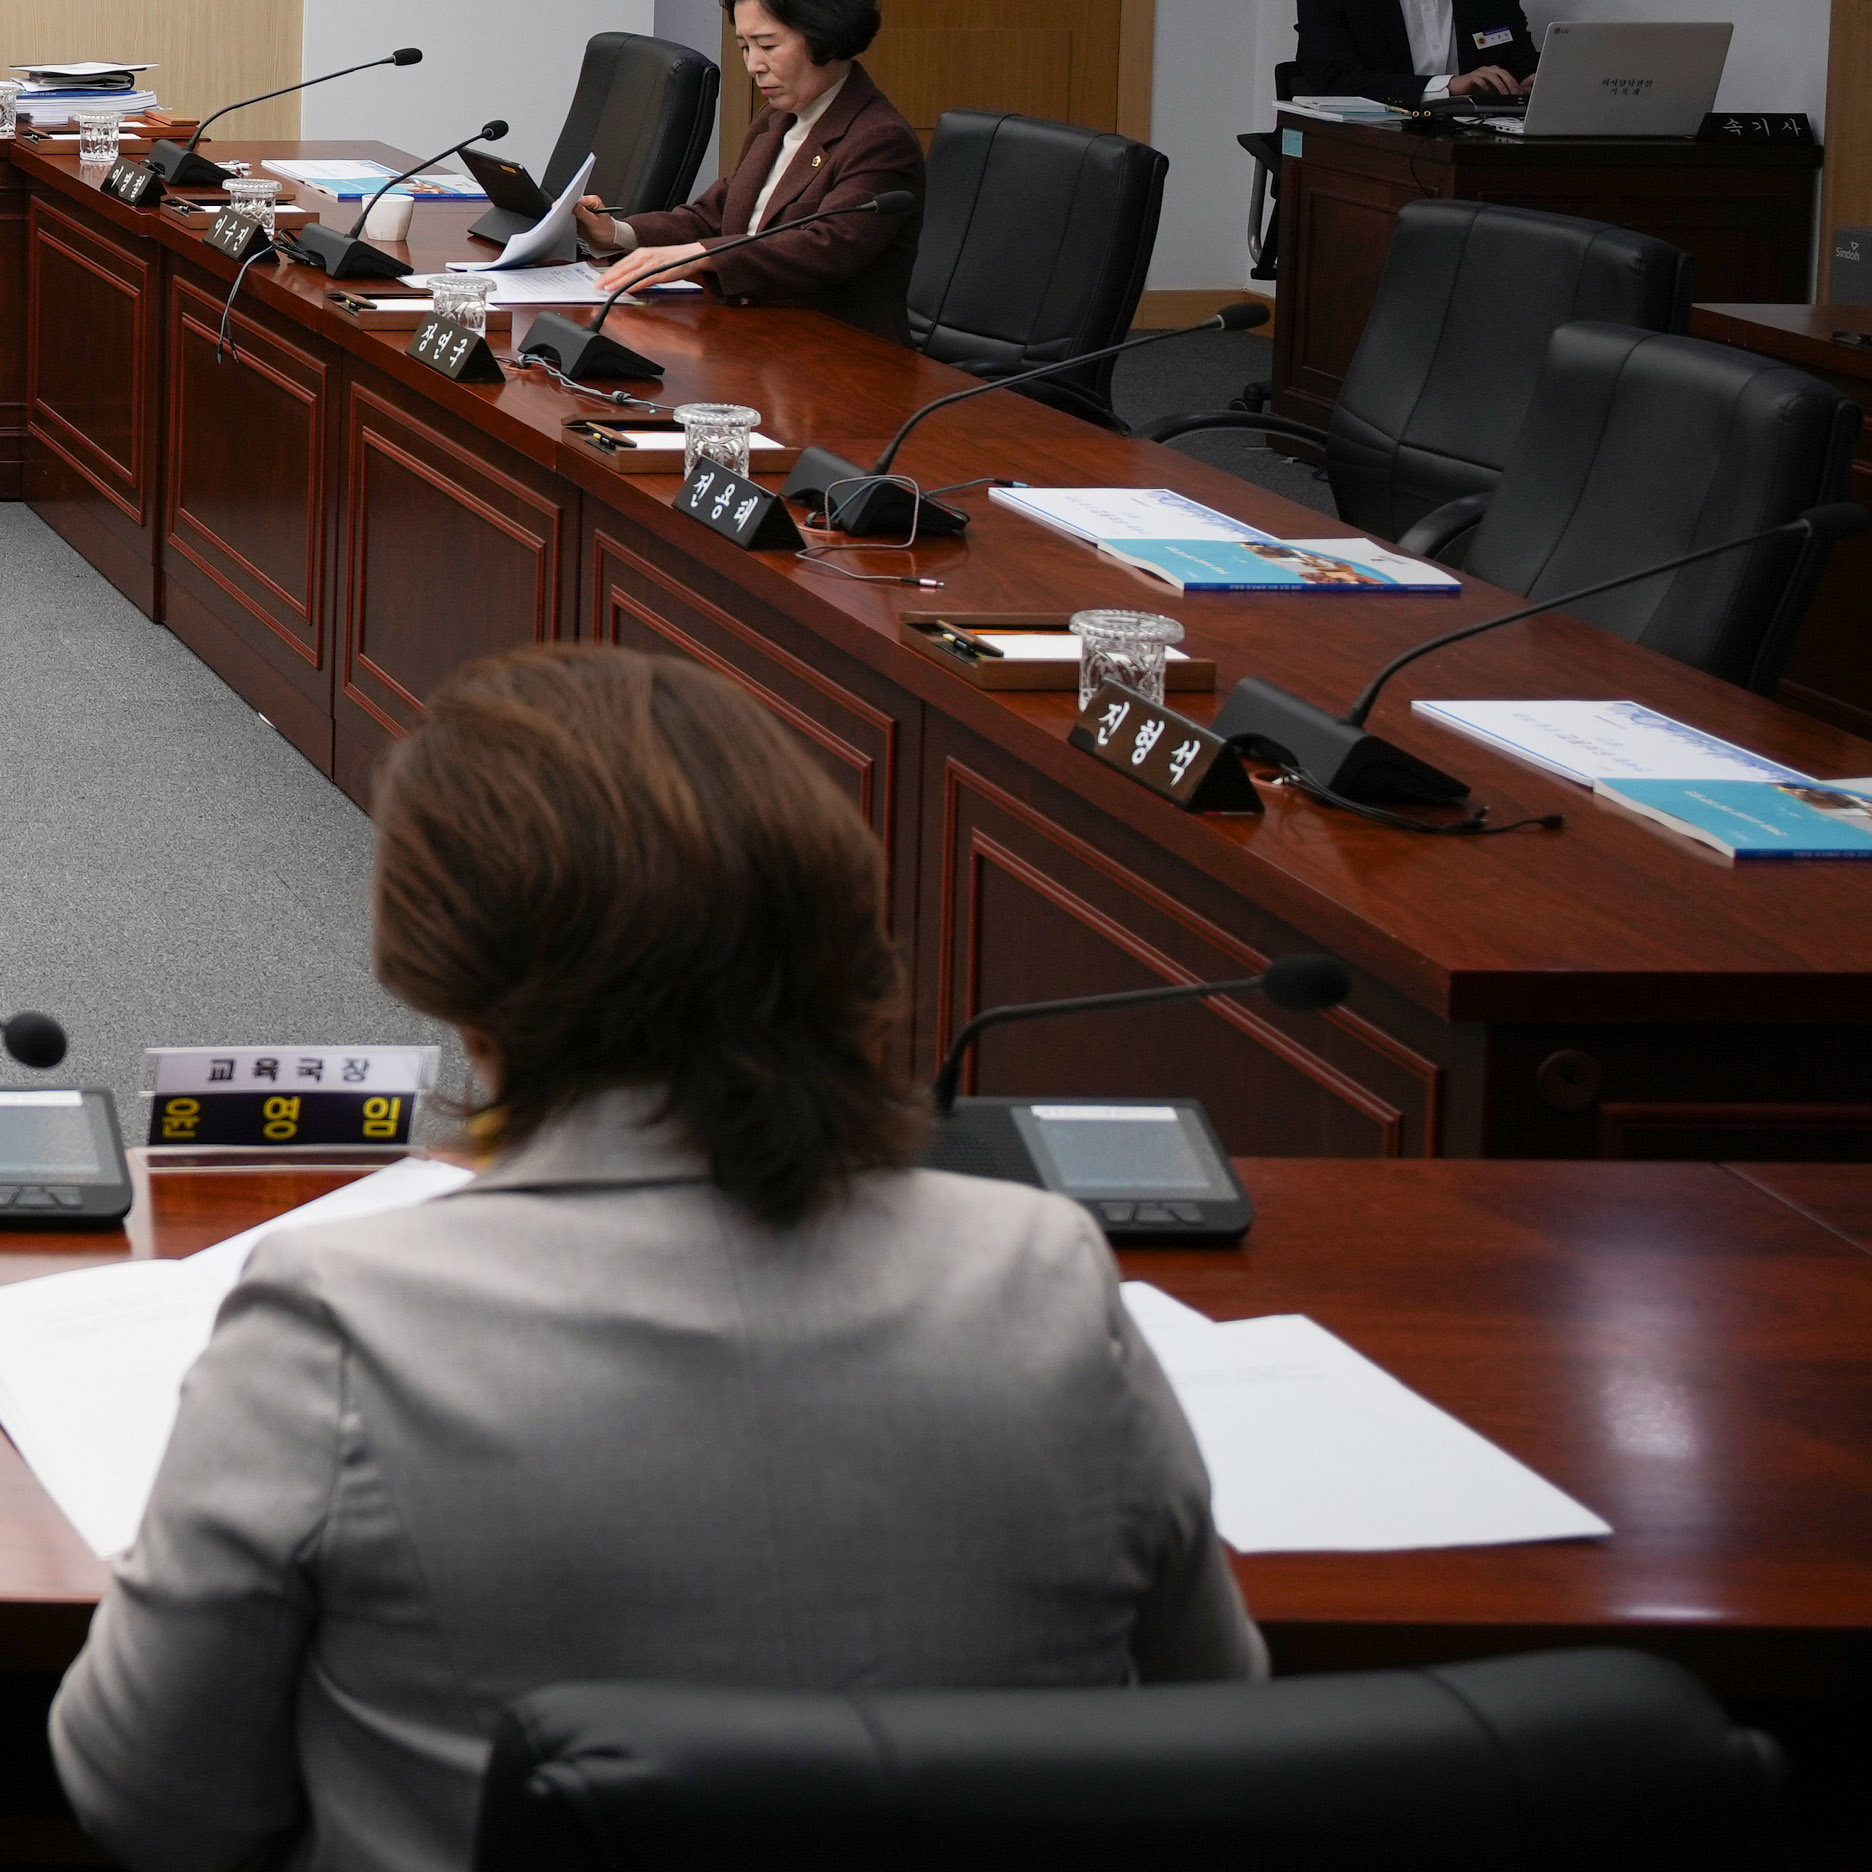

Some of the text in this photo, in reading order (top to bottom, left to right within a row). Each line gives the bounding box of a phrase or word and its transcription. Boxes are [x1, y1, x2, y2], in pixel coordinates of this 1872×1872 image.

[1722, 117, 1802, 136] 속기사
[213, 214, 250, 252] 이수진
[1835, 246, 1860, 261] Sindoh
[419, 322, 469, 370] 장연국
[690, 471, 761, 533] 전용태
[1097, 700, 1203, 787] 진형석
[207, 1056, 371, 1083] 교육국장
